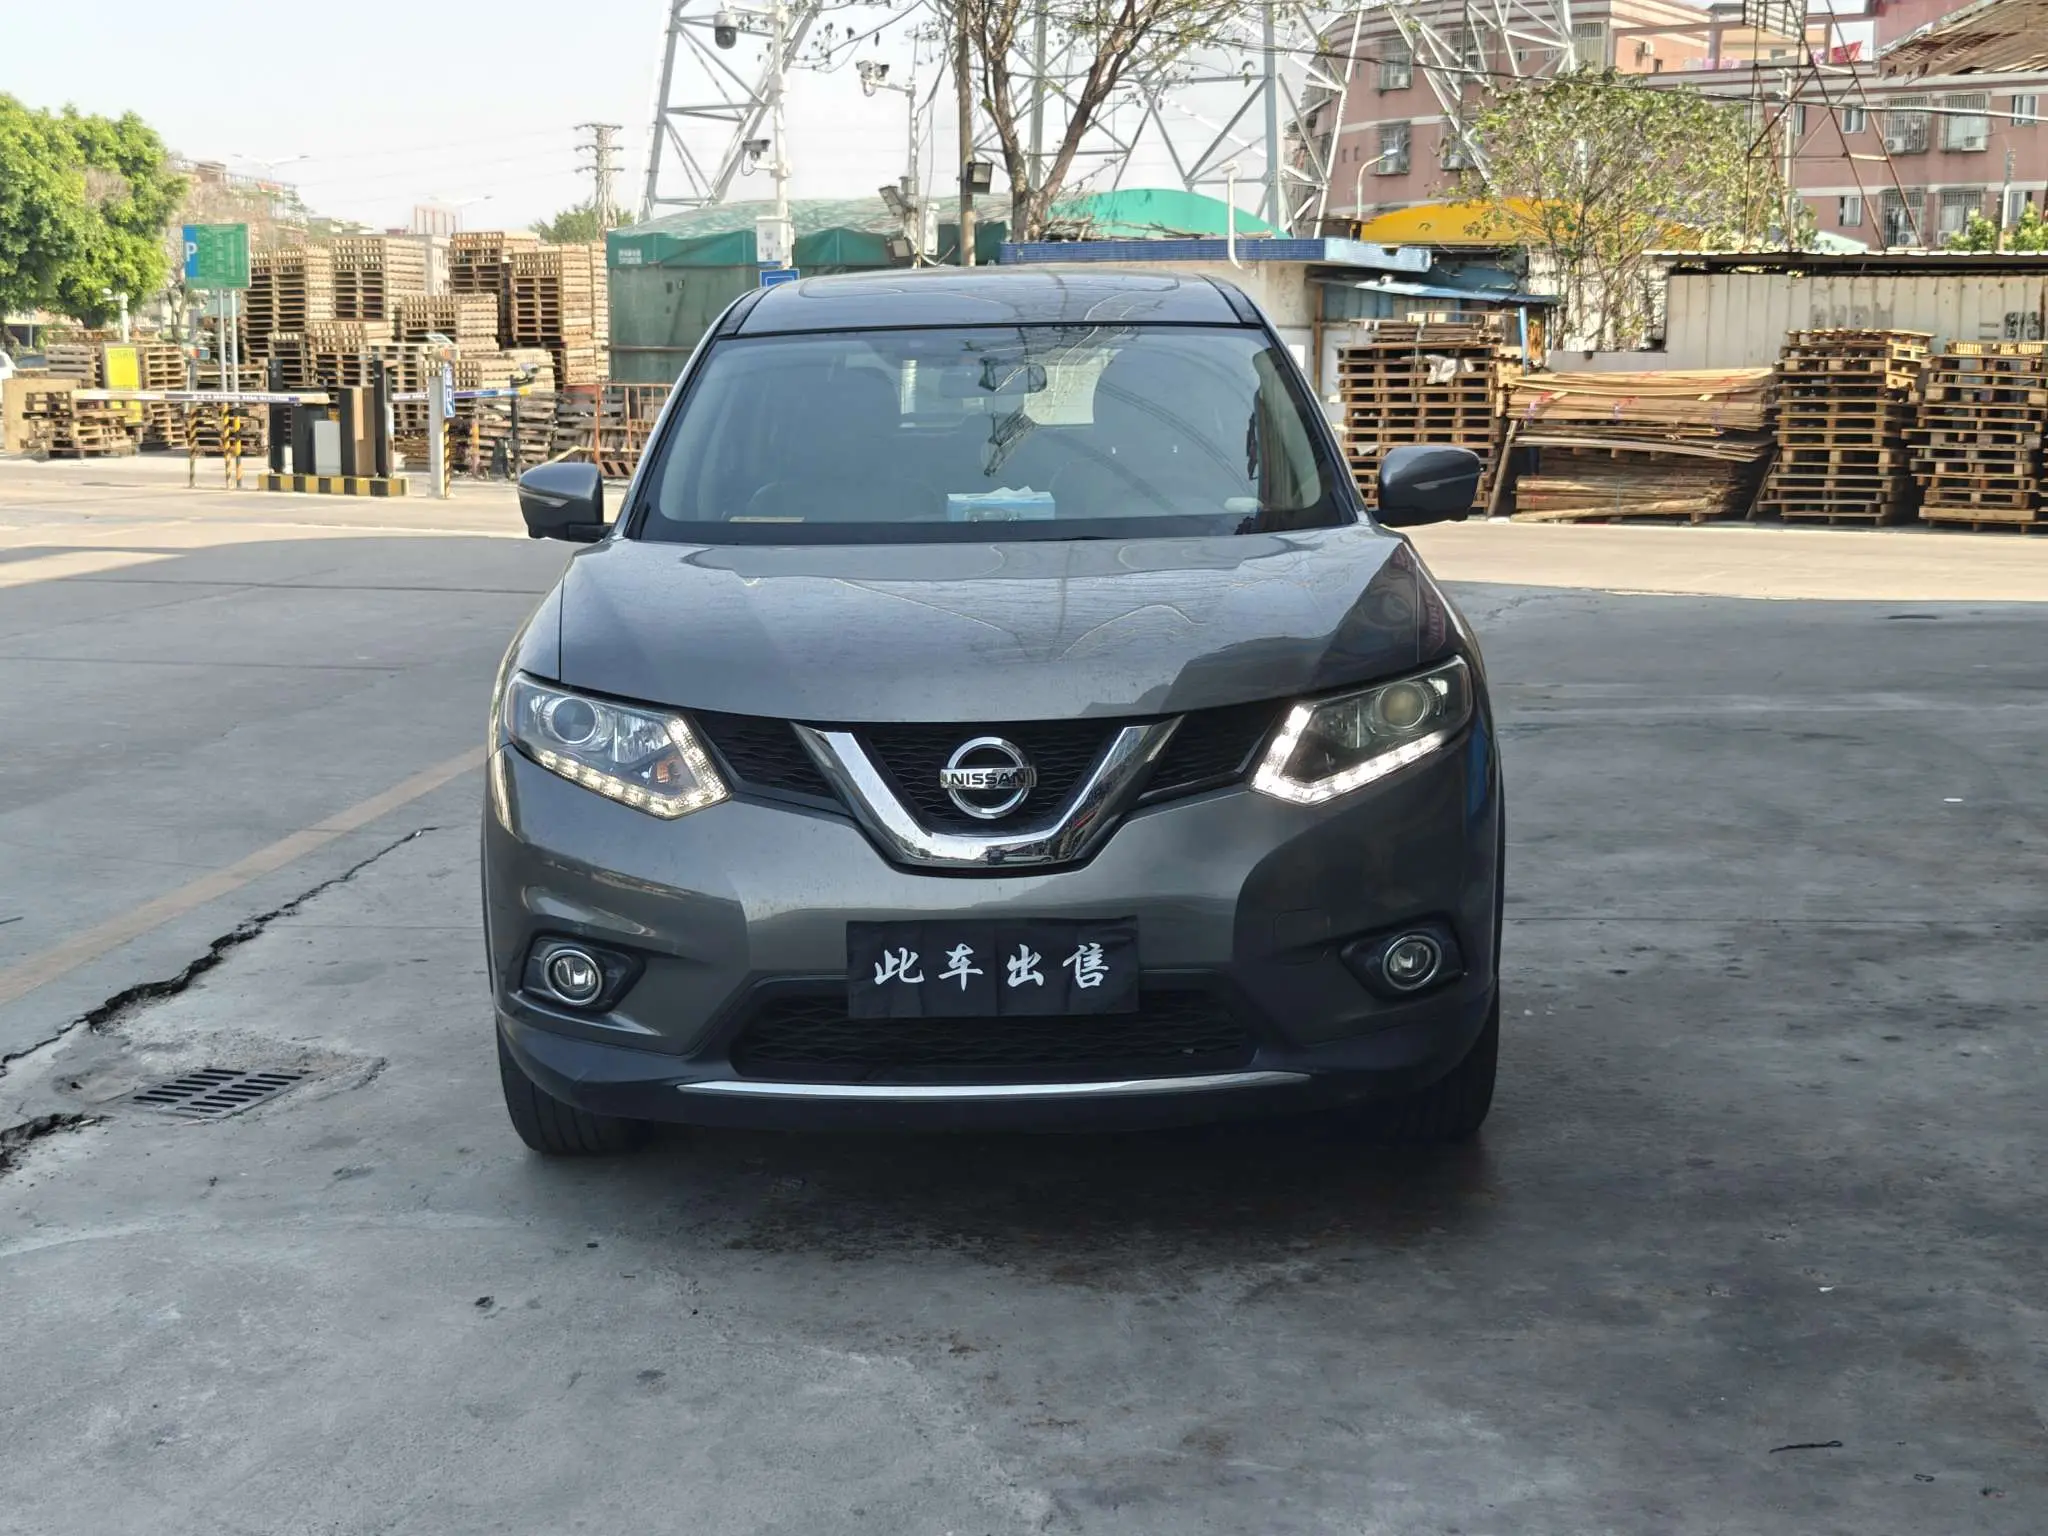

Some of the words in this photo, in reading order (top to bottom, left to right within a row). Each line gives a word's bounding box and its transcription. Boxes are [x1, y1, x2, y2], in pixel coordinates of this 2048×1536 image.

[185, 241, 198, 262] P
[950, 772, 1026, 787] NISSAN
[873, 942, 1111, 991] 此车出售
